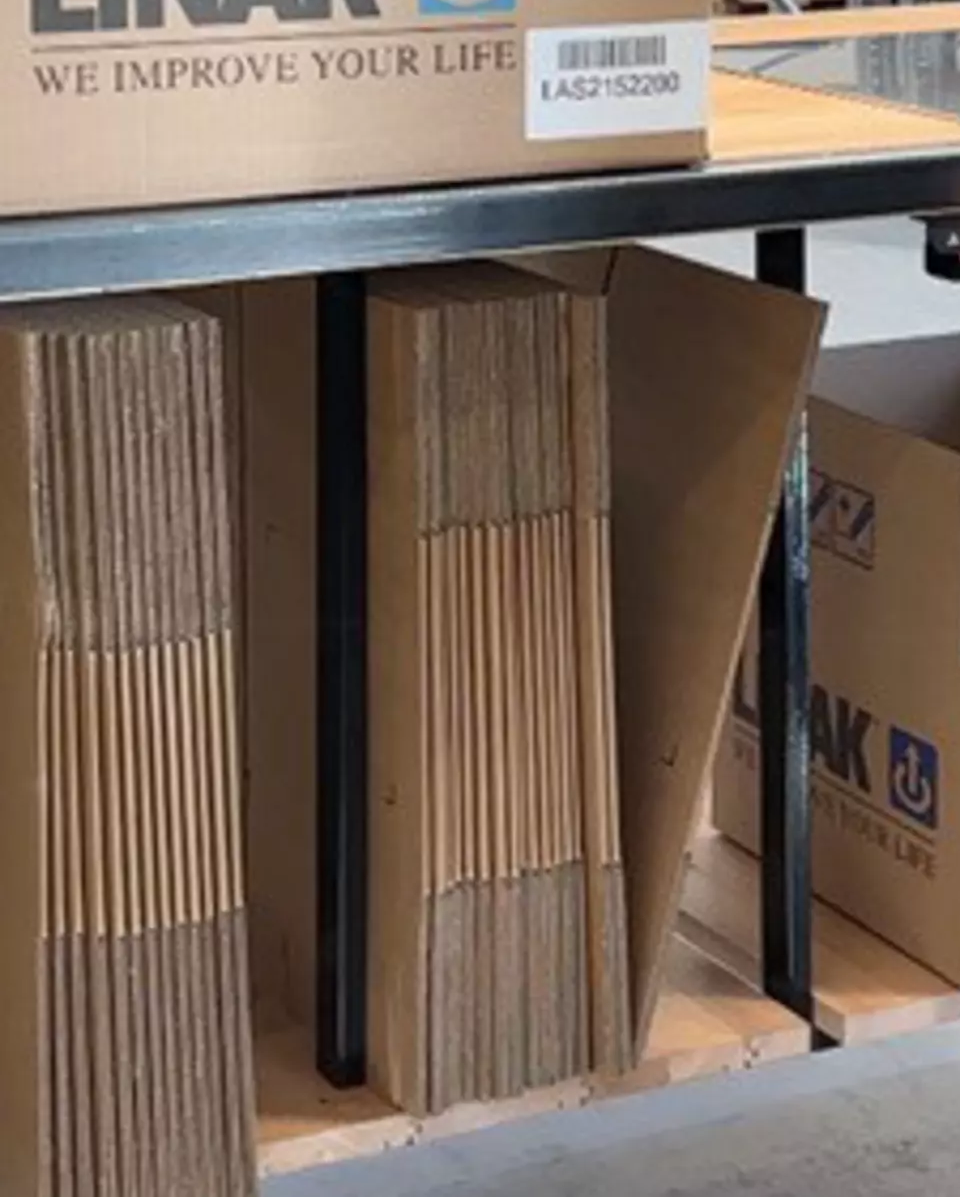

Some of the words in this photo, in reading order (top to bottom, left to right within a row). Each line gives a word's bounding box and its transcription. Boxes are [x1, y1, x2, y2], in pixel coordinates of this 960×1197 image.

[33, 62, 98, 94] WE
[114, 52, 299, 93] IMPROVE
[311, 44, 419, 80] YOUR
[434, 39, 517, 74] LIFE
